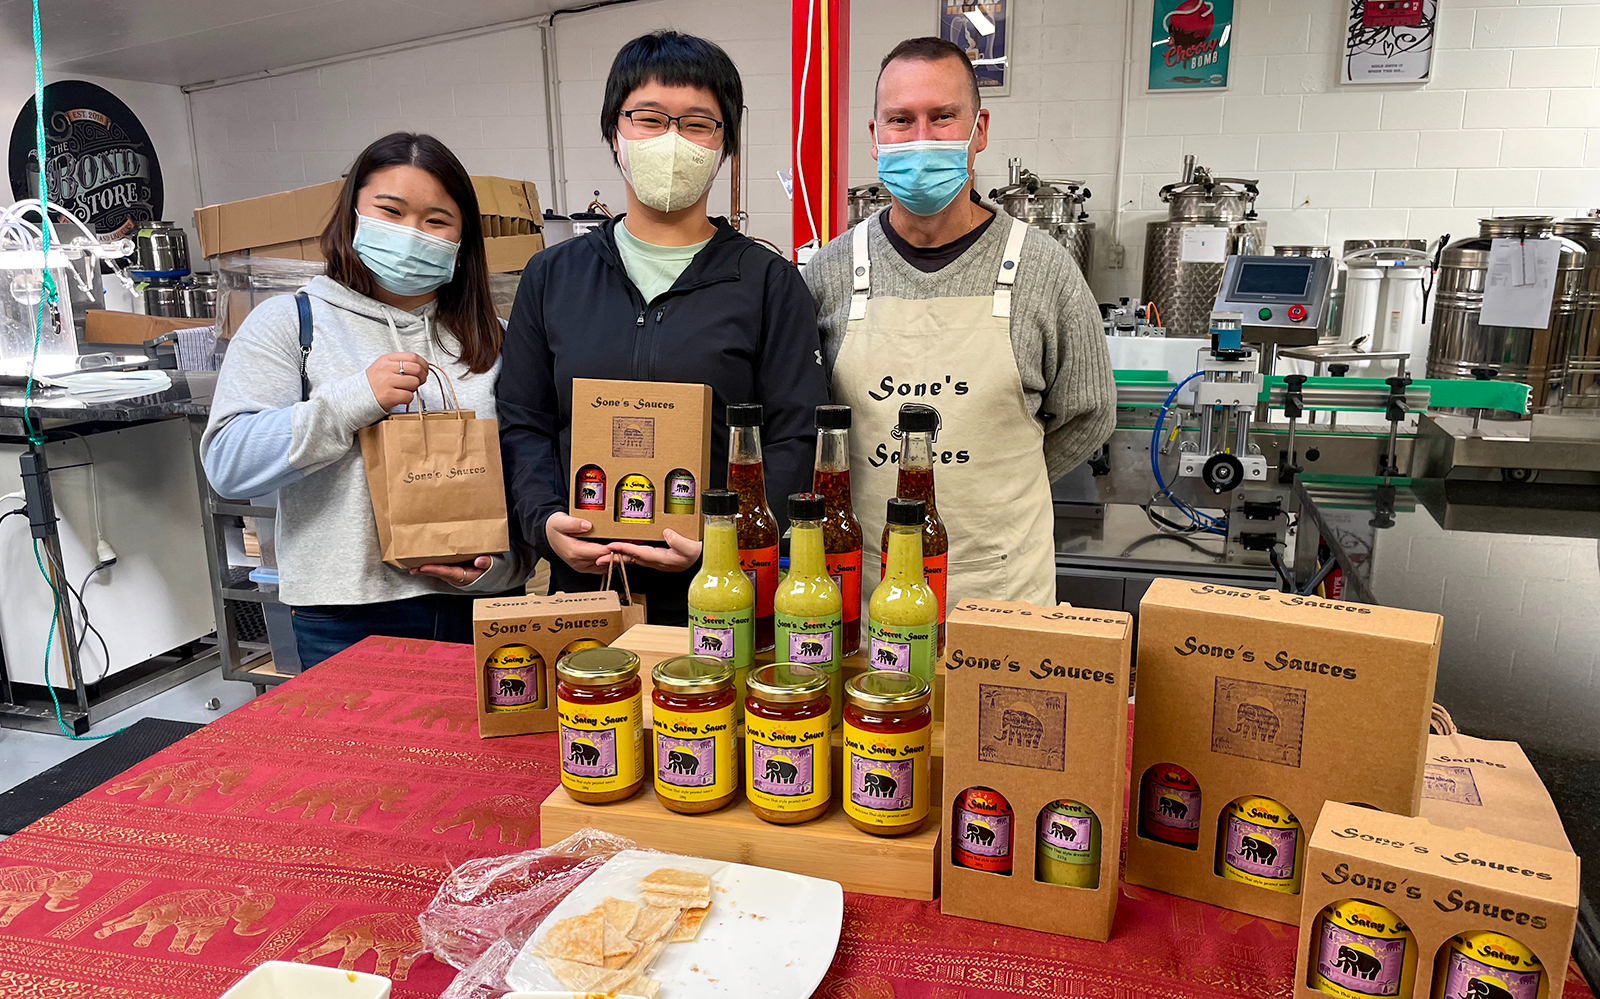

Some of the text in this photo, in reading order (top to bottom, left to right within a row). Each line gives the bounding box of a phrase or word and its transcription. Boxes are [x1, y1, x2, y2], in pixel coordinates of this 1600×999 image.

[1162, 38, 1218, 67] Cherry
[1191, 51, 1218, 69] BOMB
[51, 141, 69, 156] THE
[46, 148, 140, 200] BOND
[72, 182, 138, 218] STORE
[868, 375, 969, 401] Sone's
[591, 397, 675, 410] Sone's Sauces
[403, 466, 486, 483] Sone's Sauces
[748, 559, 771, 568] Sauce
[833, 564, 856, 574] Sauce
[485, 596, 607, 609] Sone's Sauces
[1190, 585, 1372, 615] Sone's Sauces
[701, 616, 725, 624] Secret
[728, 617, 749, 626] Sauce
[955, 604, 1127, 625] Sone's Sauces
[482, 617, 608, 638] Sone's Sauces
[800, 621, 826, 630] Secret
[877, 628, 902, 639] Secret
[904, 632, 928, 641] Sauce
[1174, 636, 1357, 680] Sone's Sauces
[945, 649, 1115, 684] Sone's Sauces
[571, 715, 597, 726] Satay
[600, 716, 628, 726] Sauce
[670, 723, 698, 735] Satay
[700, 724, 727, 734] Sauce
[768, 731, 796, 743] Satay
[799, 731, 824, 742] Sauce
[867, 744, 896, 756] Satay
[899, 745, 924, 756] Sauce
[967, 799, 997, 811] Salad
[1051, 799, 1082, 812] Secret
[1247, 808, 1279, 823] Satay
[1331, 828, 1553, 881] Sone's Sauces
[1321, 864, 1548, 930] Sone's Sauces
[1346, 914, 1385, 933] Satay
[1477, 945, 1520, 966] Satay
